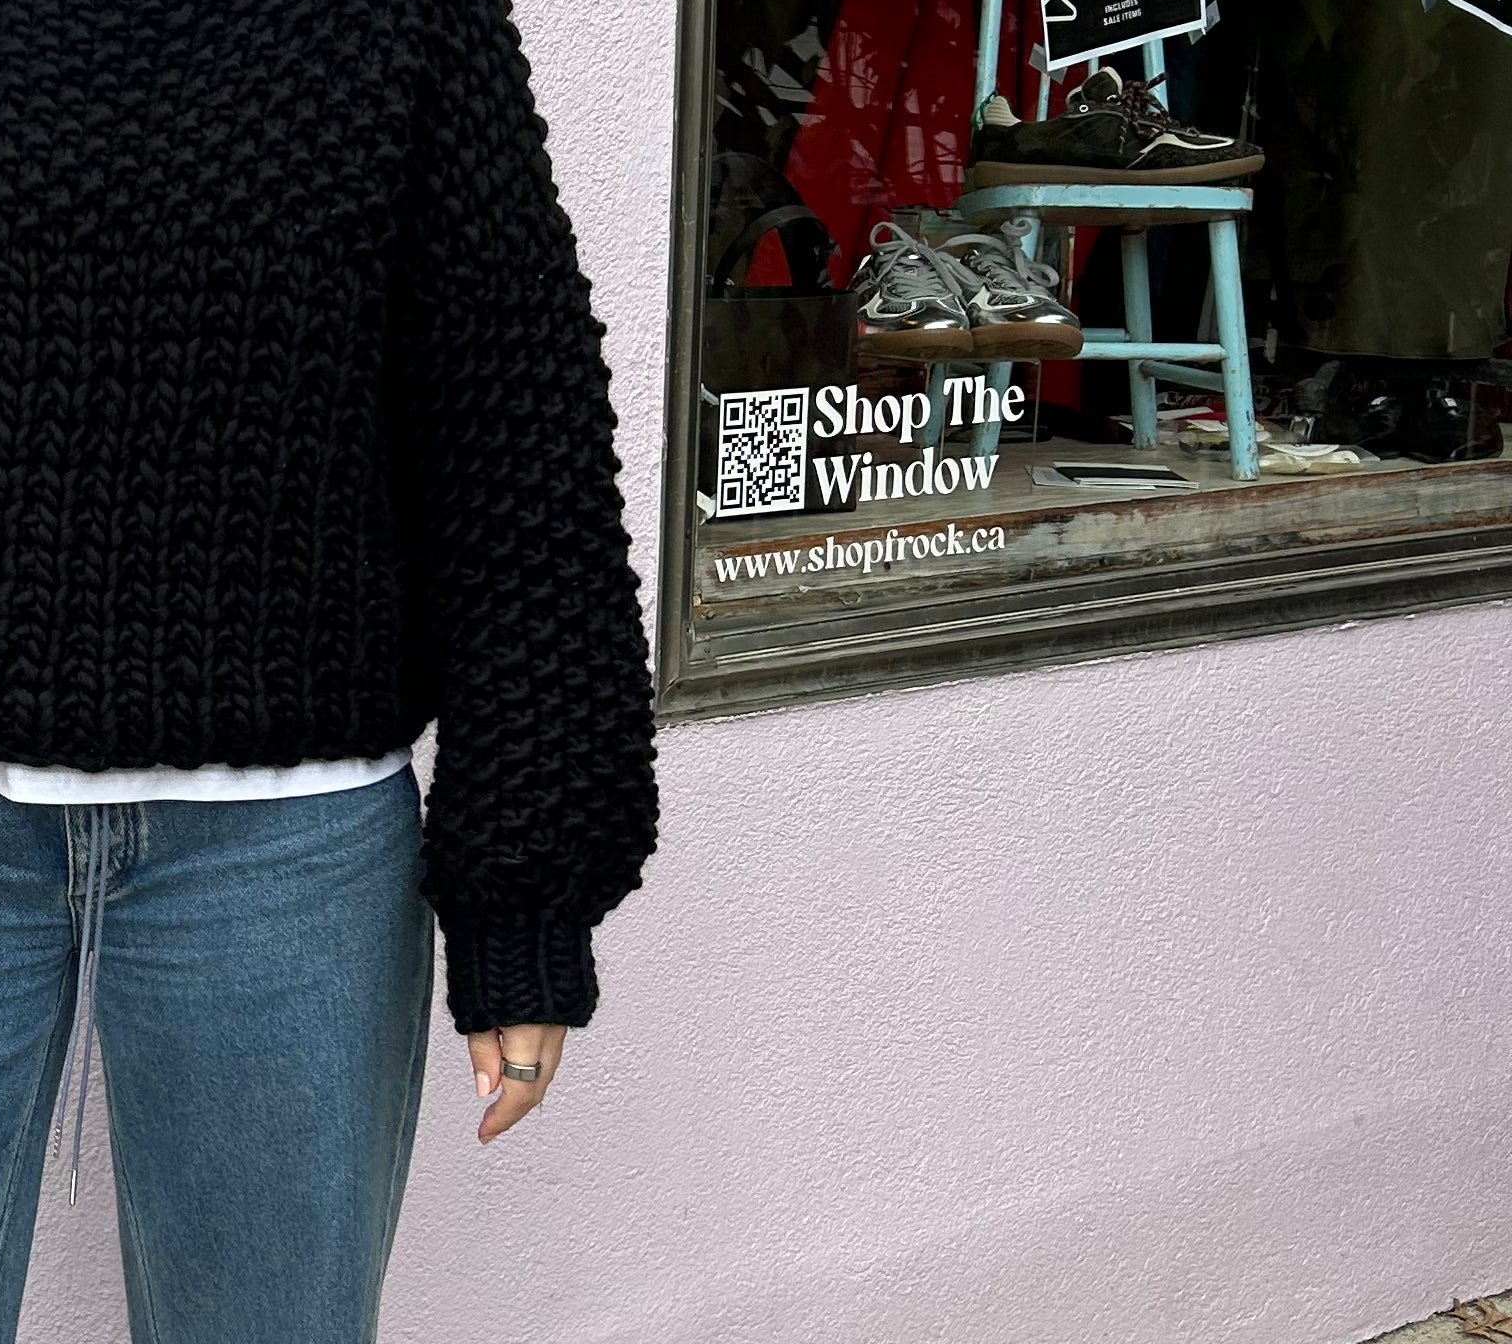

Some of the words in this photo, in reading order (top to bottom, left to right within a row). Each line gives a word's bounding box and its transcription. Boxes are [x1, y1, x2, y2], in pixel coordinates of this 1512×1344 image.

[1103, 14, 1121, 26] SALE
[1121, 8, 1142, 21] ITEMS
[812, 384, 931, 445] Shop
[942, 375, 1025, 427] The
[811, 446, 1000, 506] Window
[713, 522, 1006, 583] www.shopfrock.ca
